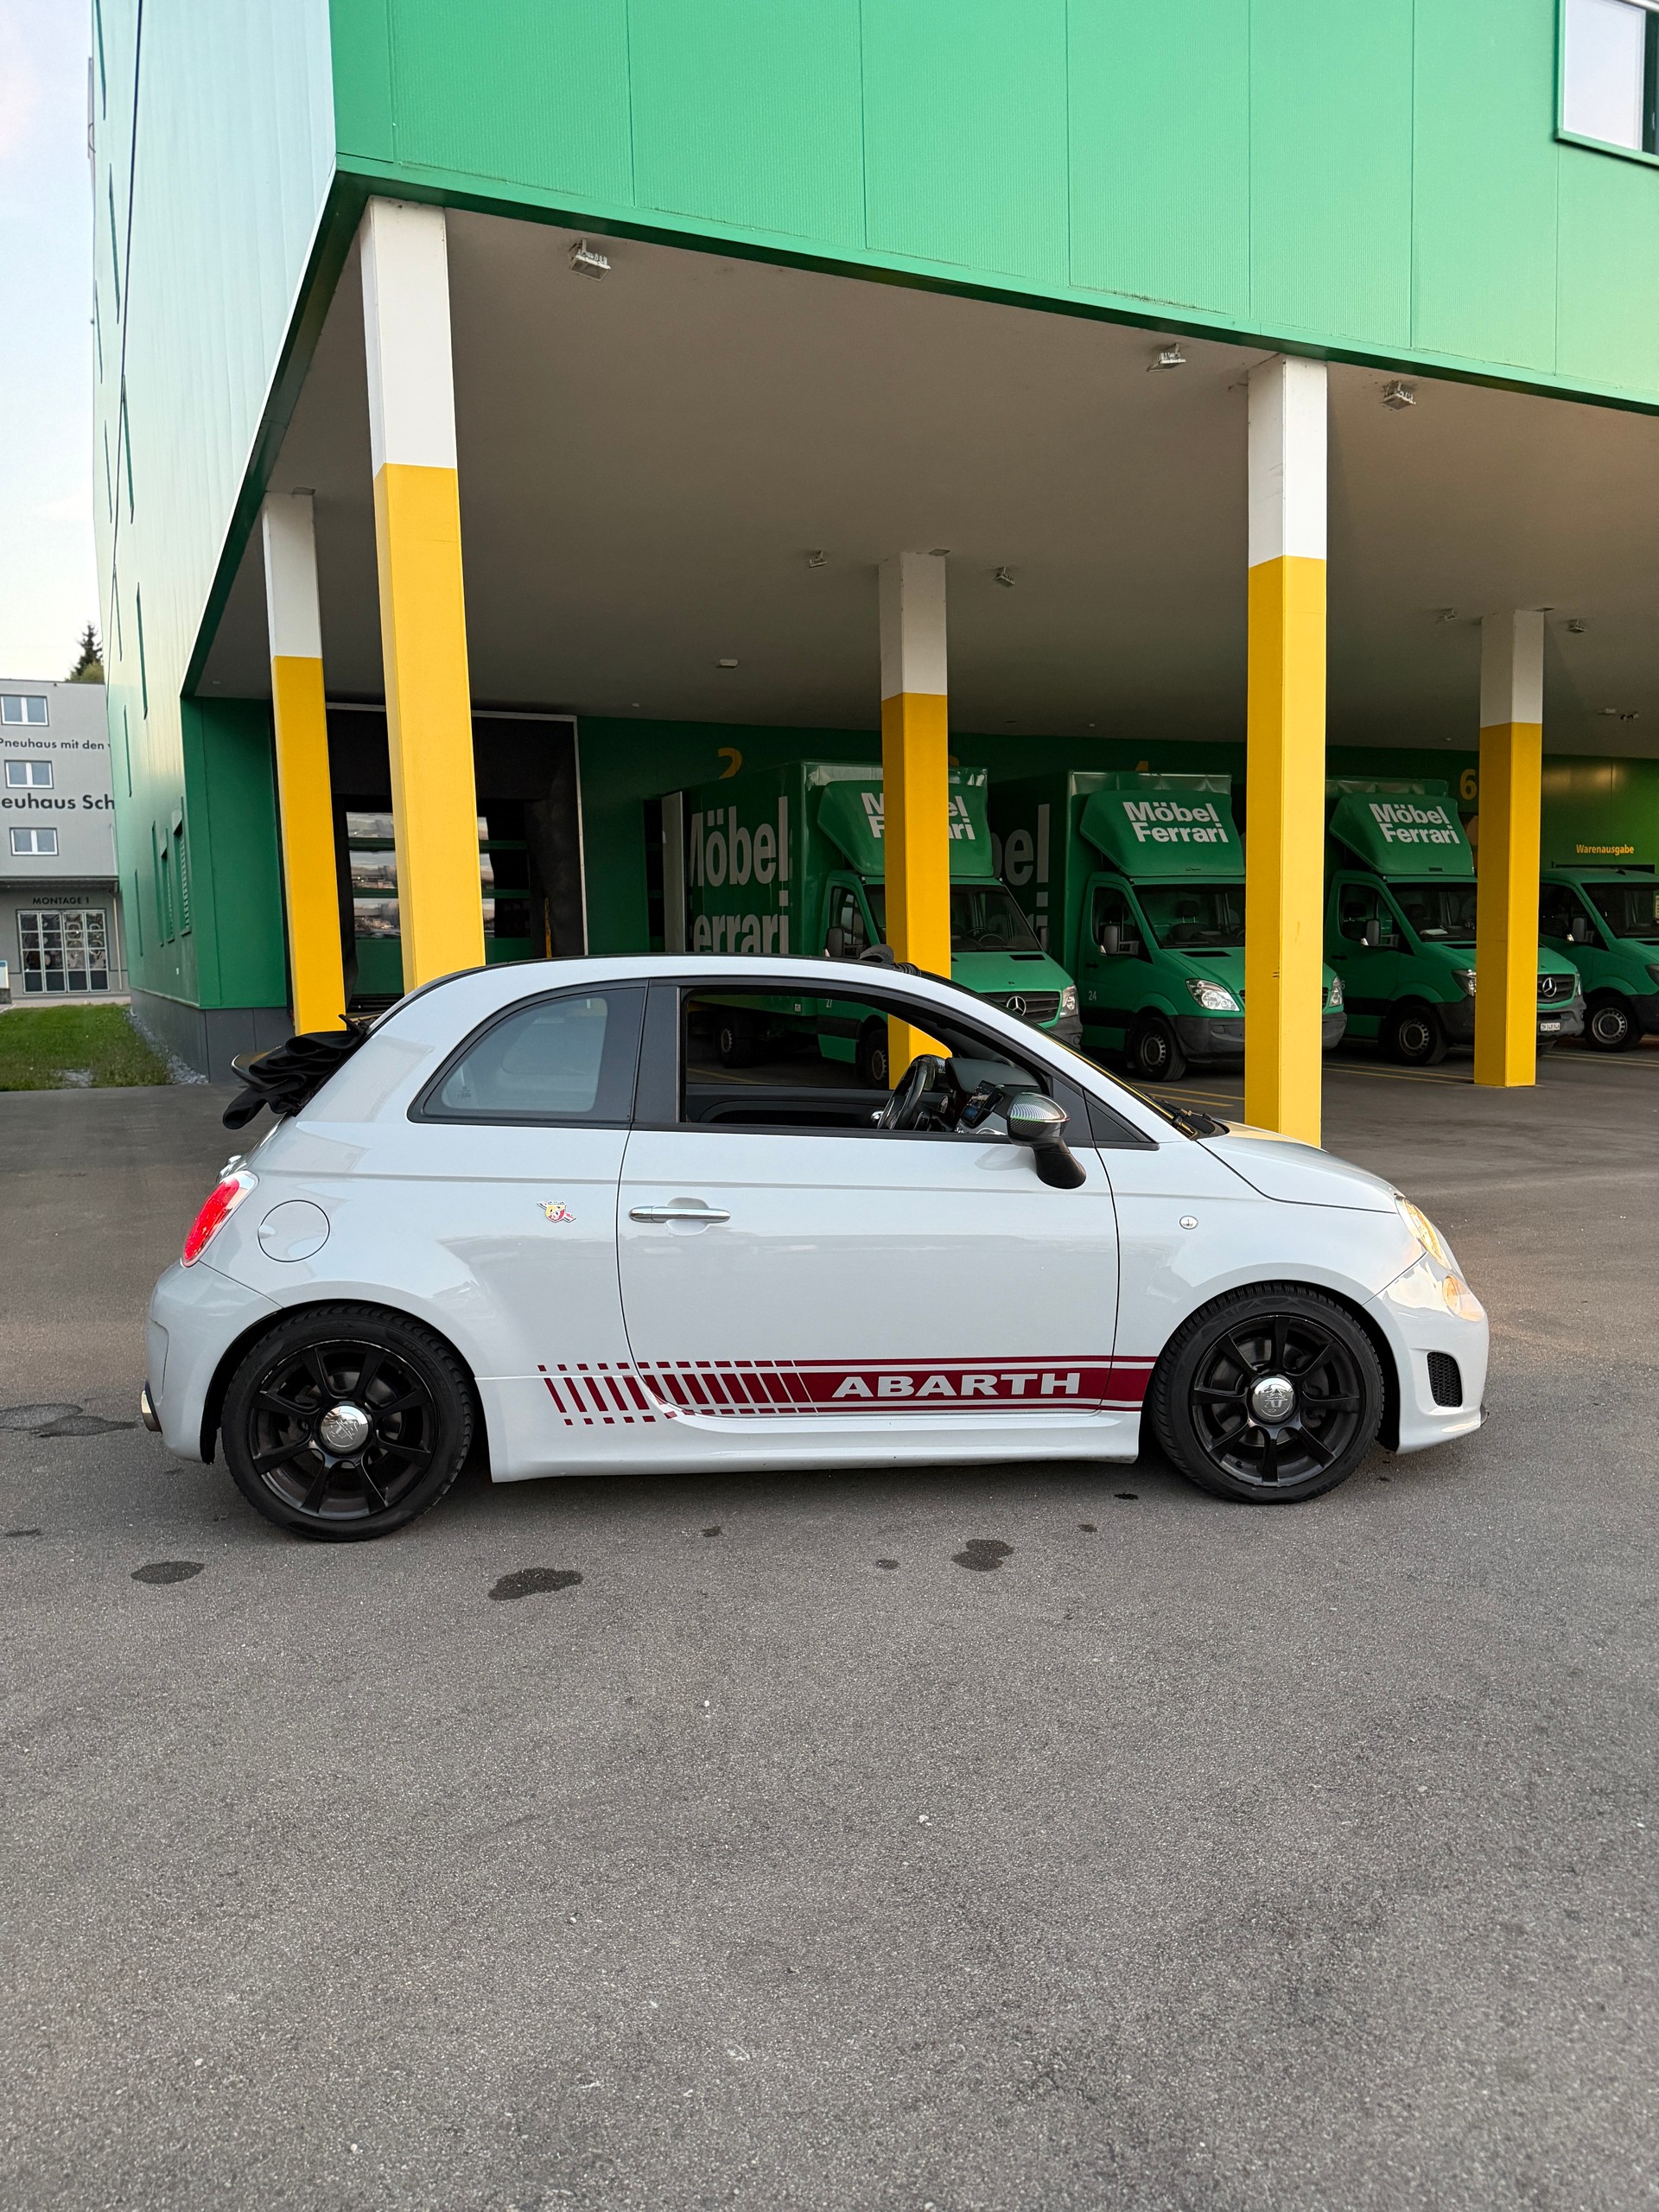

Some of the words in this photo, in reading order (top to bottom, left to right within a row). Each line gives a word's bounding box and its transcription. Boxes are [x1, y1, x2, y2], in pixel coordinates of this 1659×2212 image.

[60, 740, 79, 749] mit
[82, 740, 105, 750] den
[1459, 768, 1478, 800] 6
[2, 792, 76, 810] euhaus
[82, 793, 115, 810] Sch
[1122, 801, 1219, 822] Möbel
[1369, 804, 1451, 824] Möbel
[1131, 822, 1229, 842] Ferrari
[1378, 823, 1460, 844] Ferrari
[1576, 844, 1635, 856] Warenausgabe
[690, 889, 789, 954] errari
[1088, 989, 1097, 1001] 24
[831, 1372, 1080, 1398] ABARTH
